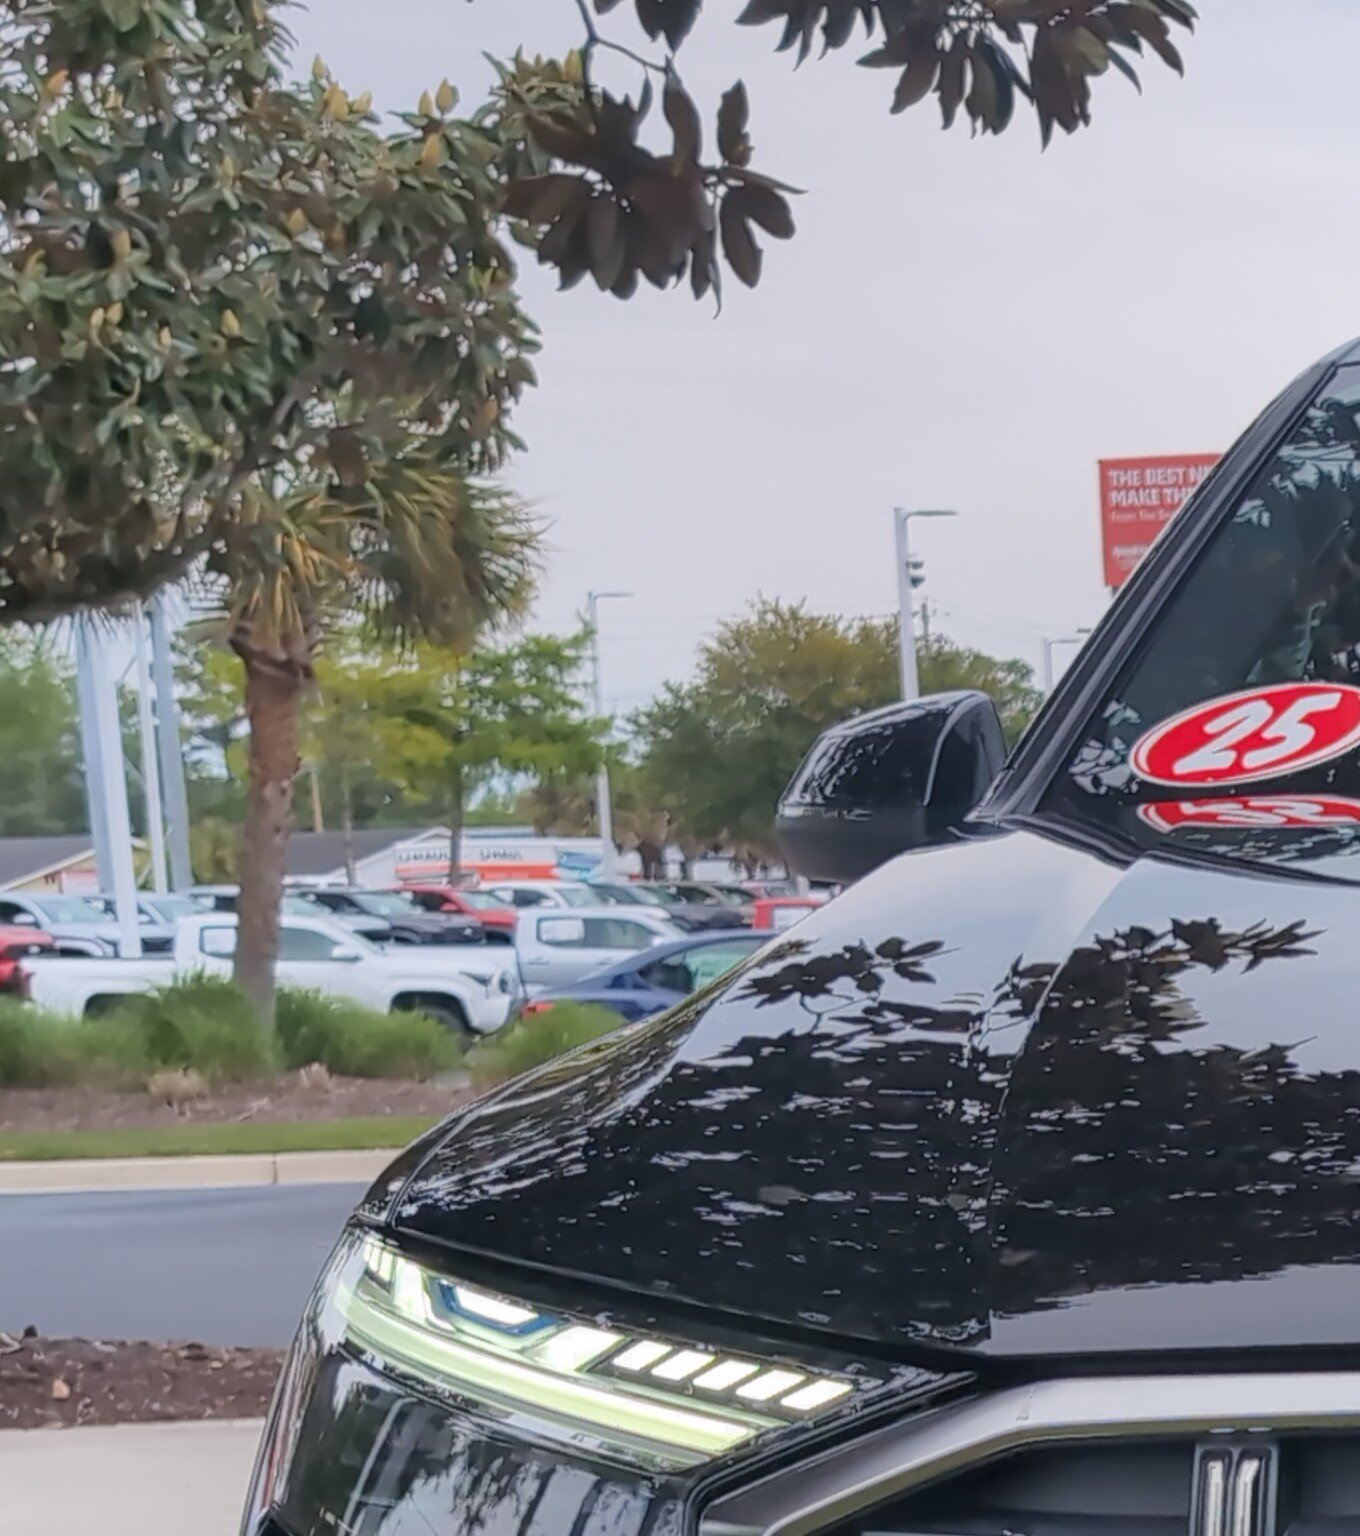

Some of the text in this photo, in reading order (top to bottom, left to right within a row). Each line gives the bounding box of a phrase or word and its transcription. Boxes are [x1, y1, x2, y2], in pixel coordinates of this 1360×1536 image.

[1109, 469, 1141, 487] THE
[1145, 467, 1185, 486] BEST
[1110, 488, 1159, 507] MAKE
[1173, 692, 1342, 775] 25
